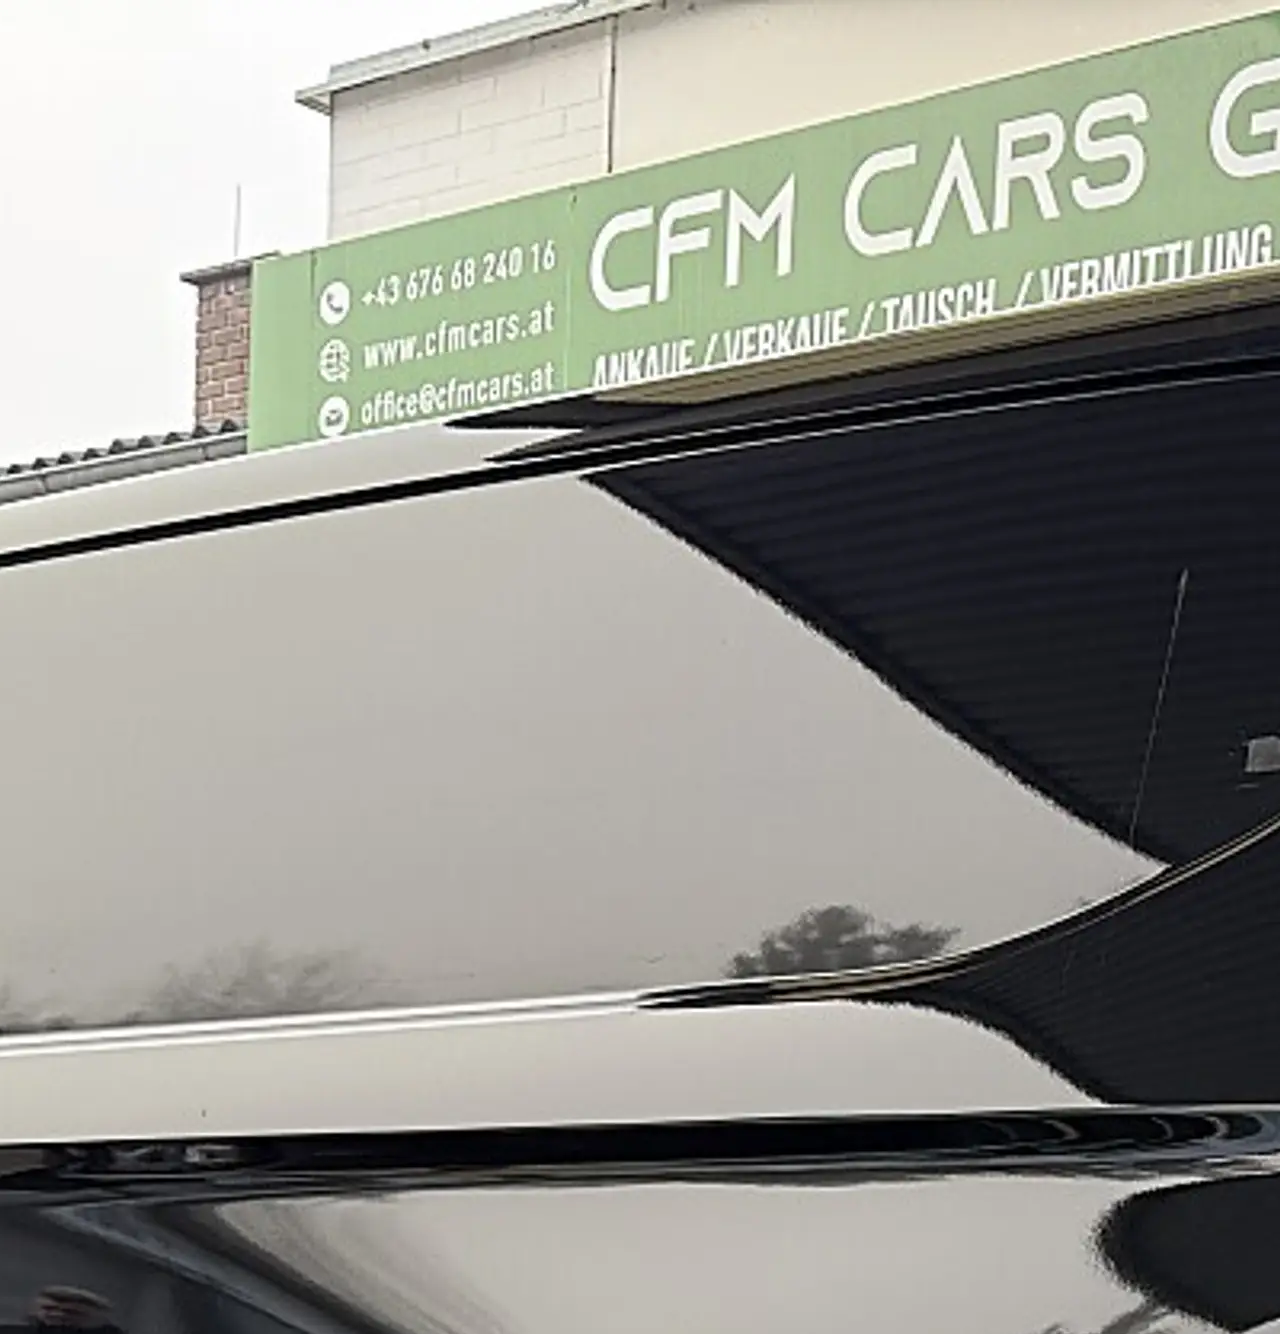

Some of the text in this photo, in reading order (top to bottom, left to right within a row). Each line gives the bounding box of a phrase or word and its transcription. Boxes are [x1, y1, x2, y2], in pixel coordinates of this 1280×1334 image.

[589, 173, 797, 311] CFM
[843, 91, 1150, 257] CARS
[361, 239, 556, 306] +43 676 68 240 16
[880, 278, 996, 333] TAUSCH
[364, 300, 555, 370] www.cfmcars.at
[361, 361, 554, 425] office@cfmcars.at
